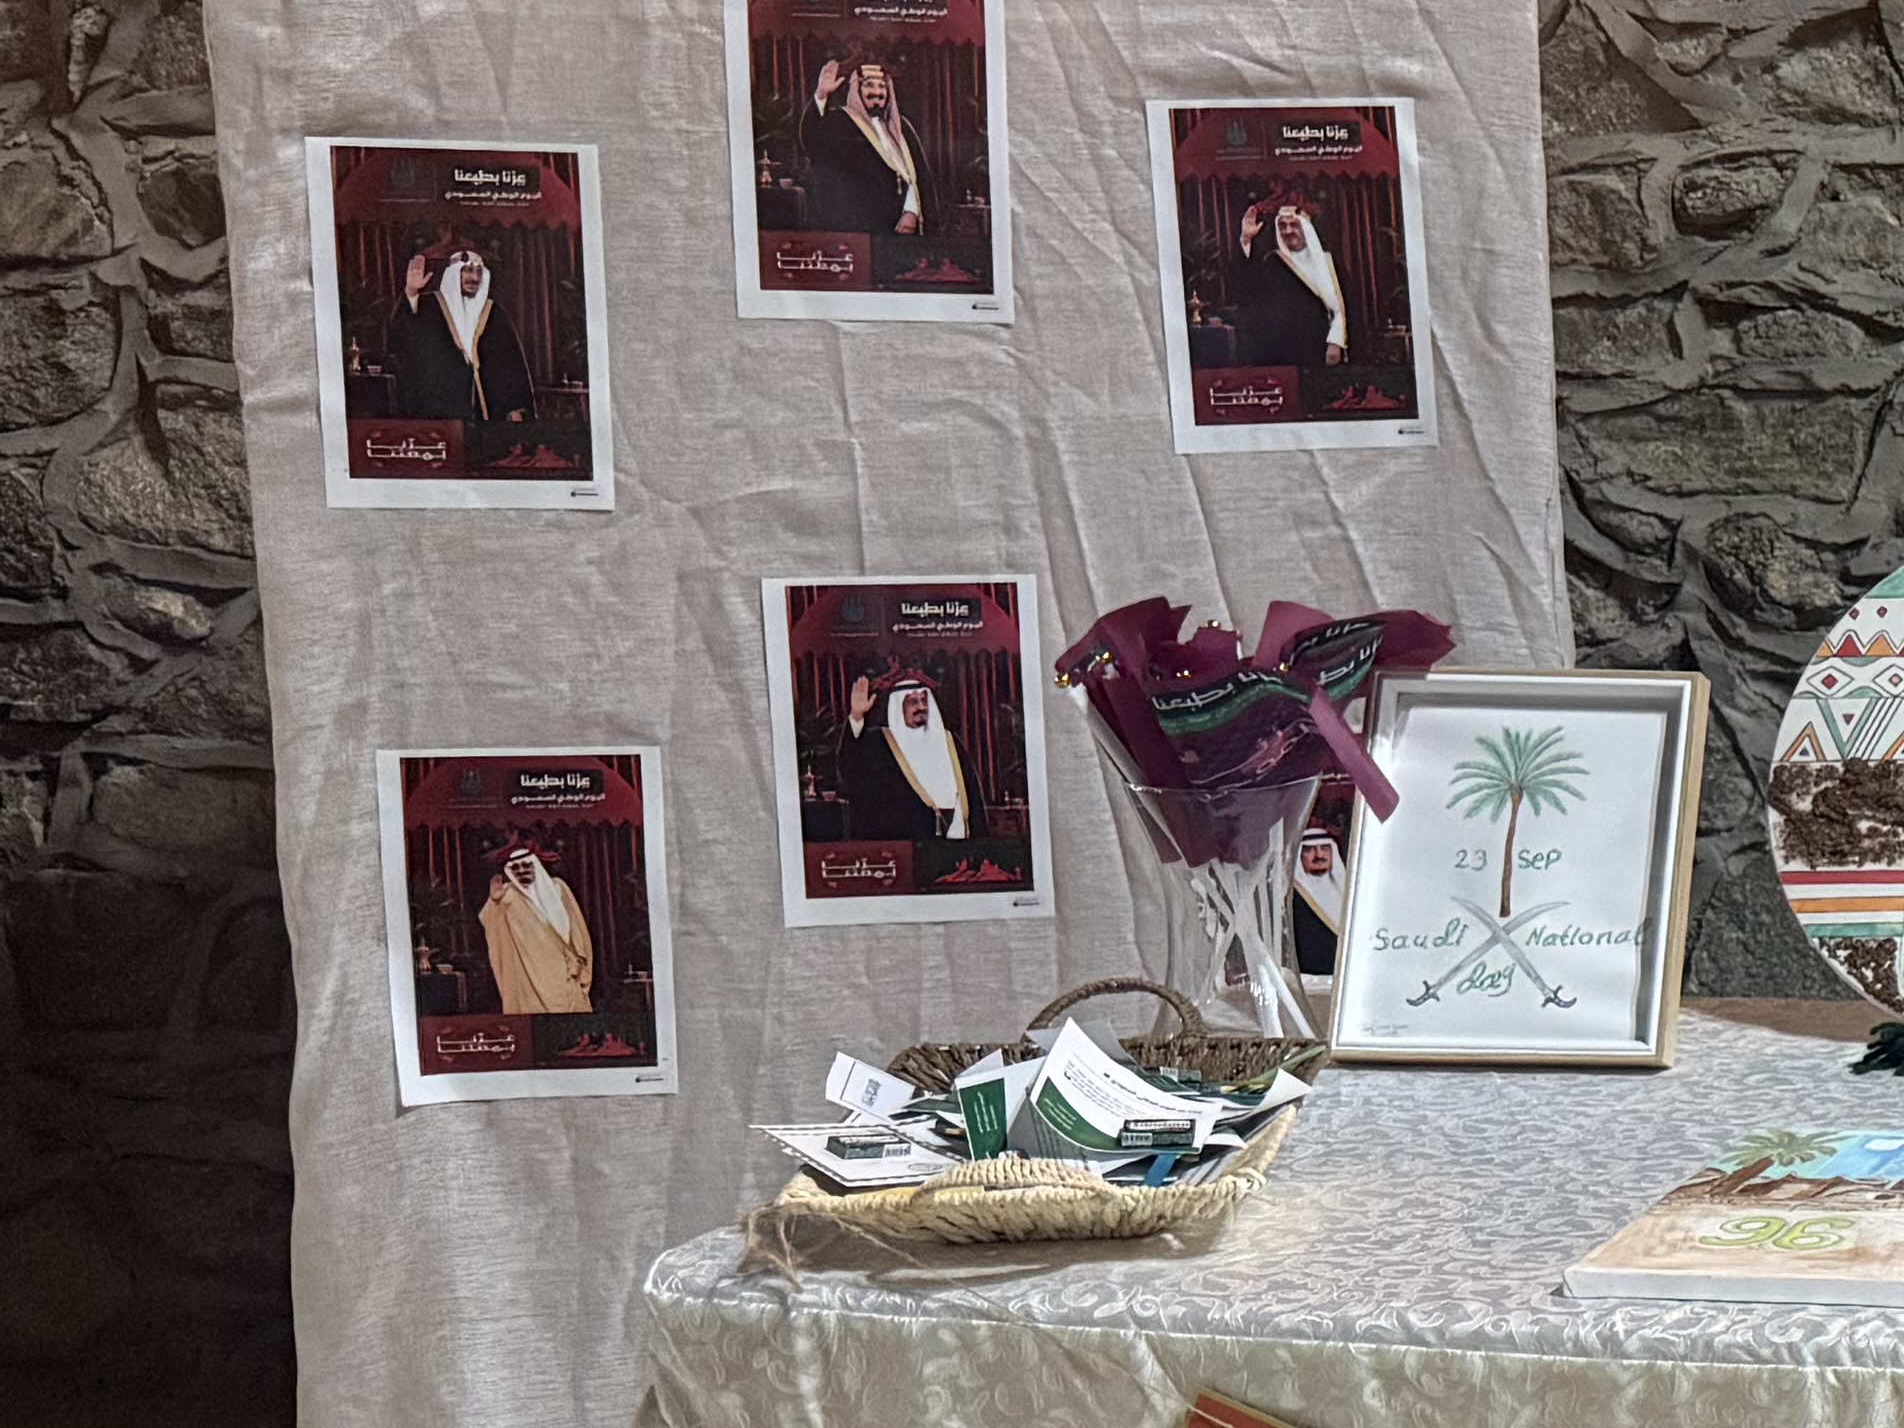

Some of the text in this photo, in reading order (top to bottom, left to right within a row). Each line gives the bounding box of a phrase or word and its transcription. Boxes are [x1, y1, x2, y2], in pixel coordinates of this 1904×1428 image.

[1454, 848, 1488, 872] 23
[1372, 917, 1654, 951] Saudi National
[1694, 1213, 1857, 1254] 96
